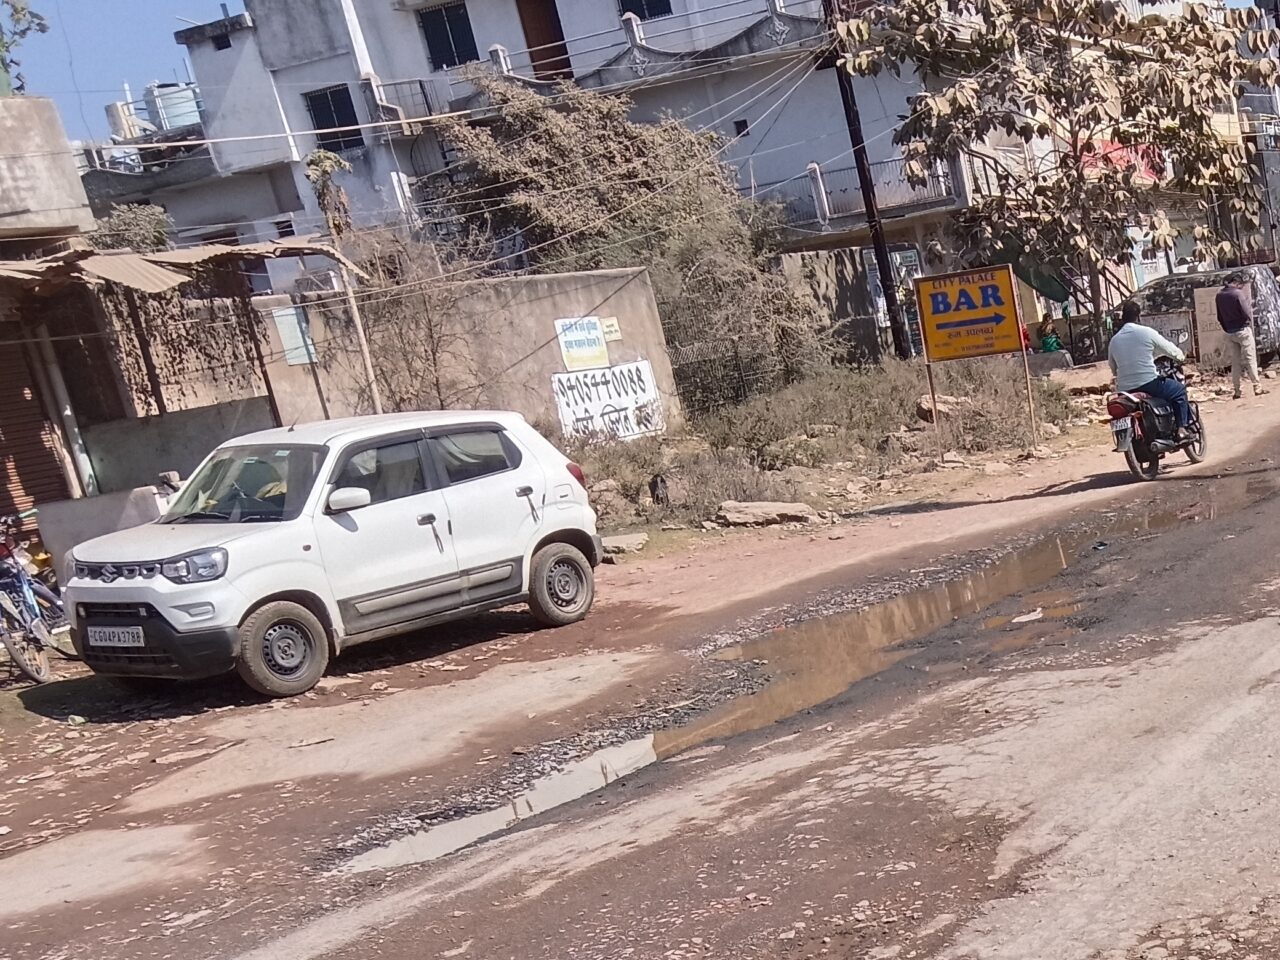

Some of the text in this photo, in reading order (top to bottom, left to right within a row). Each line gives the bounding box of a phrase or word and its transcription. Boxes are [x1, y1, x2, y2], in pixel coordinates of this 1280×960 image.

[932, 272, 997, 290] CITY PALACE
[929, 284, 1005, 315] BAR
[557, 365, 646, 408] 9405440088
